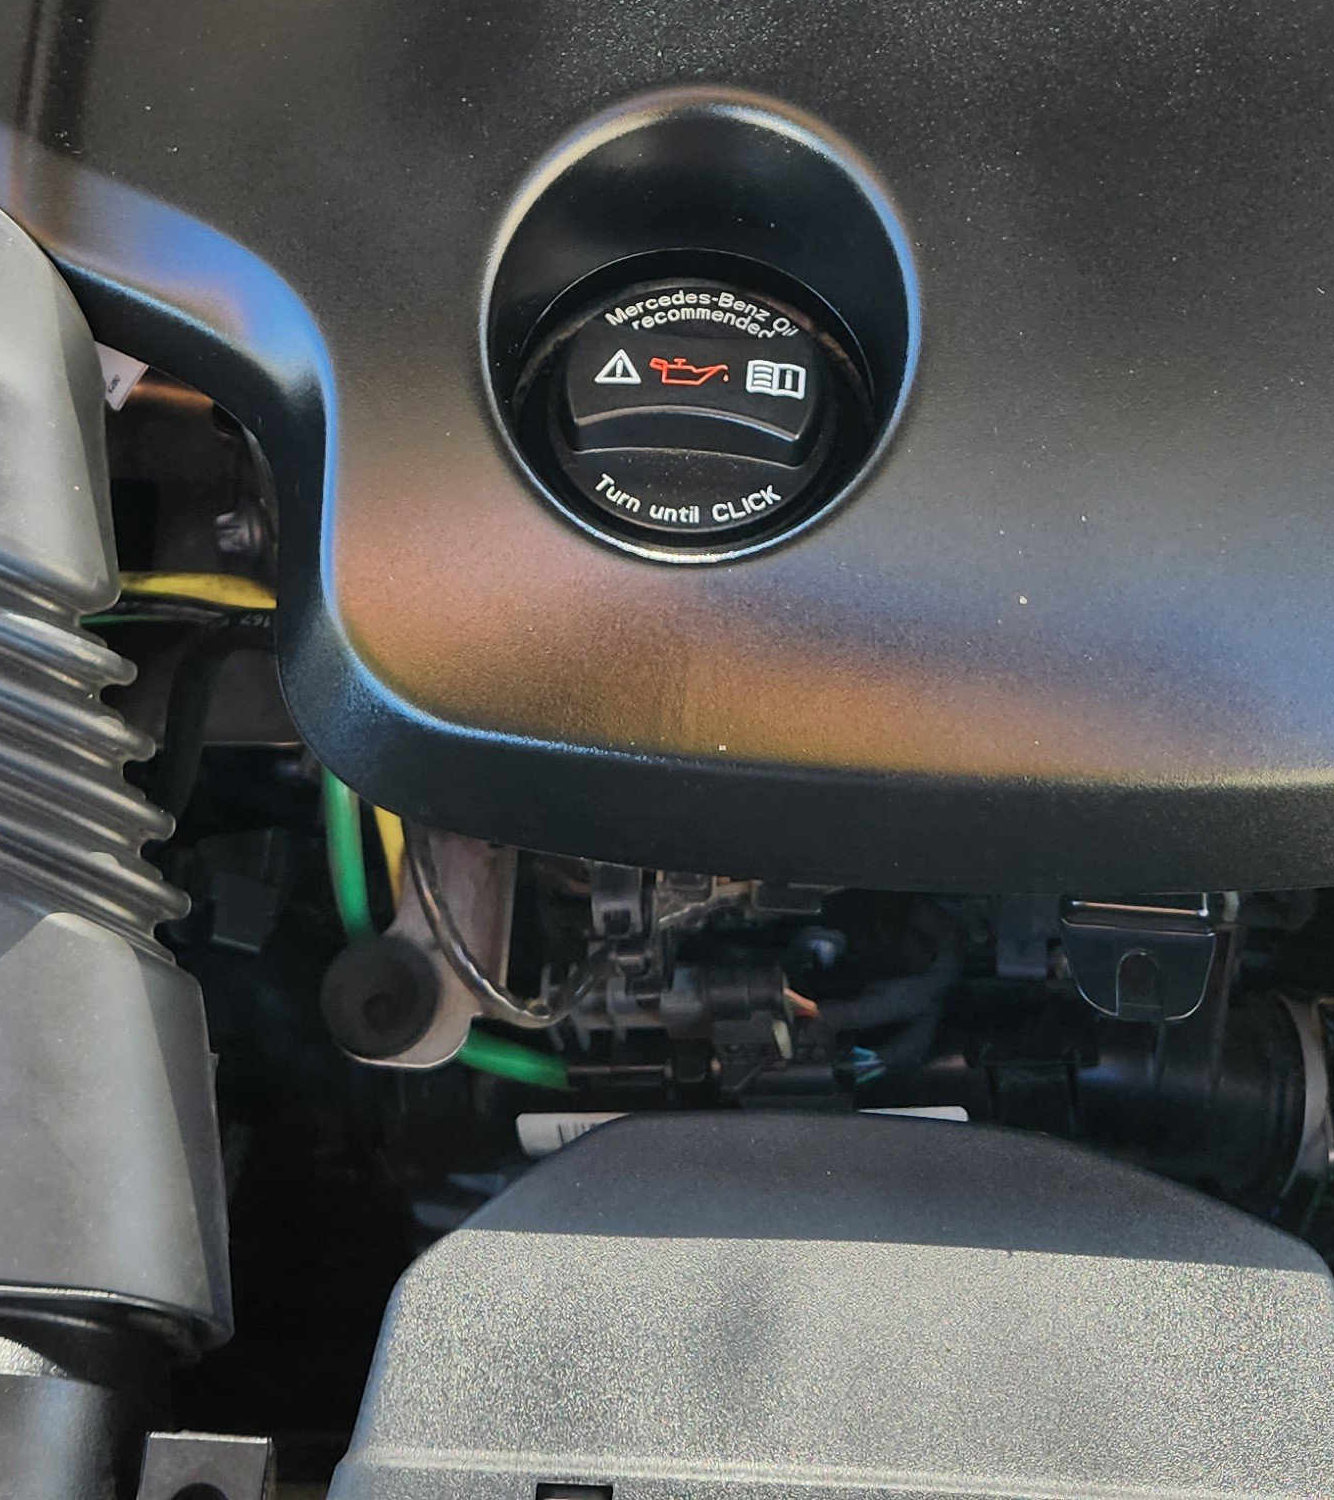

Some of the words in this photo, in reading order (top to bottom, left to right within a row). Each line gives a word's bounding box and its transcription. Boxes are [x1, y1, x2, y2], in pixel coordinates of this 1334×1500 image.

[605, 290, 770, 326] Mercedes-Benz
[773, 317, 799, 337] Oil
[595, 473, 641, 513] Turn
[649, 504, 700, 524] until
[712, 485, 782, 523] CLICK
